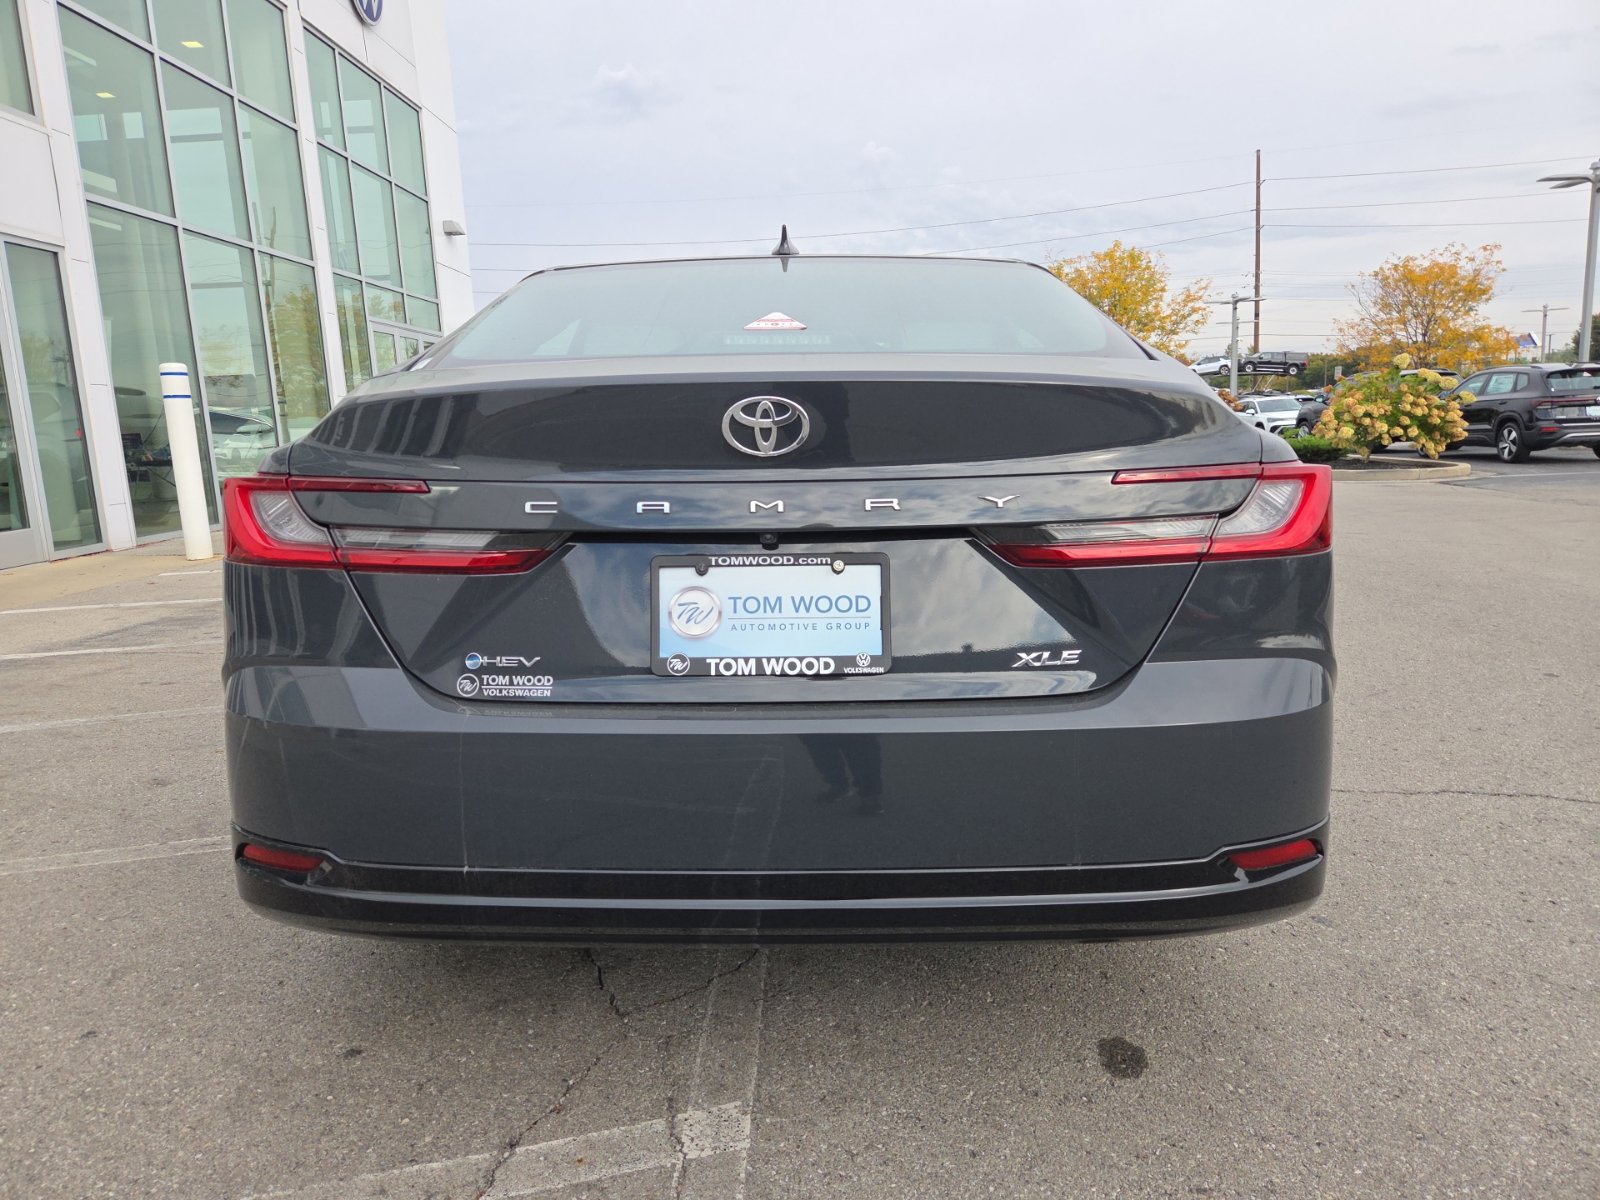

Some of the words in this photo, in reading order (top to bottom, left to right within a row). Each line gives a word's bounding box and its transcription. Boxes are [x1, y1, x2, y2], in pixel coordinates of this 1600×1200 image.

[524, 494, 1020, 514] CAMRY
[708, 556, 831, 566] TOMWOOD.com
[728, 596, 782, 614] TOM
[791, 595, 872, 613] WOOD
[731, 623, 818, 631] AUTOMOTIVE
[826, 622, 870, 631] GROUP
[482, 655, 541, 668] HEV
[1011, 649, 1082, 668] XLE
[706, 658, 756, 675] TOM
[762, 657, 835, 675] WOOD
[481, 675, 510, 685] TOM
[513, 675, 553, 686] WOOD
[483, 688, 551, 697] VOLKSWAGEN
